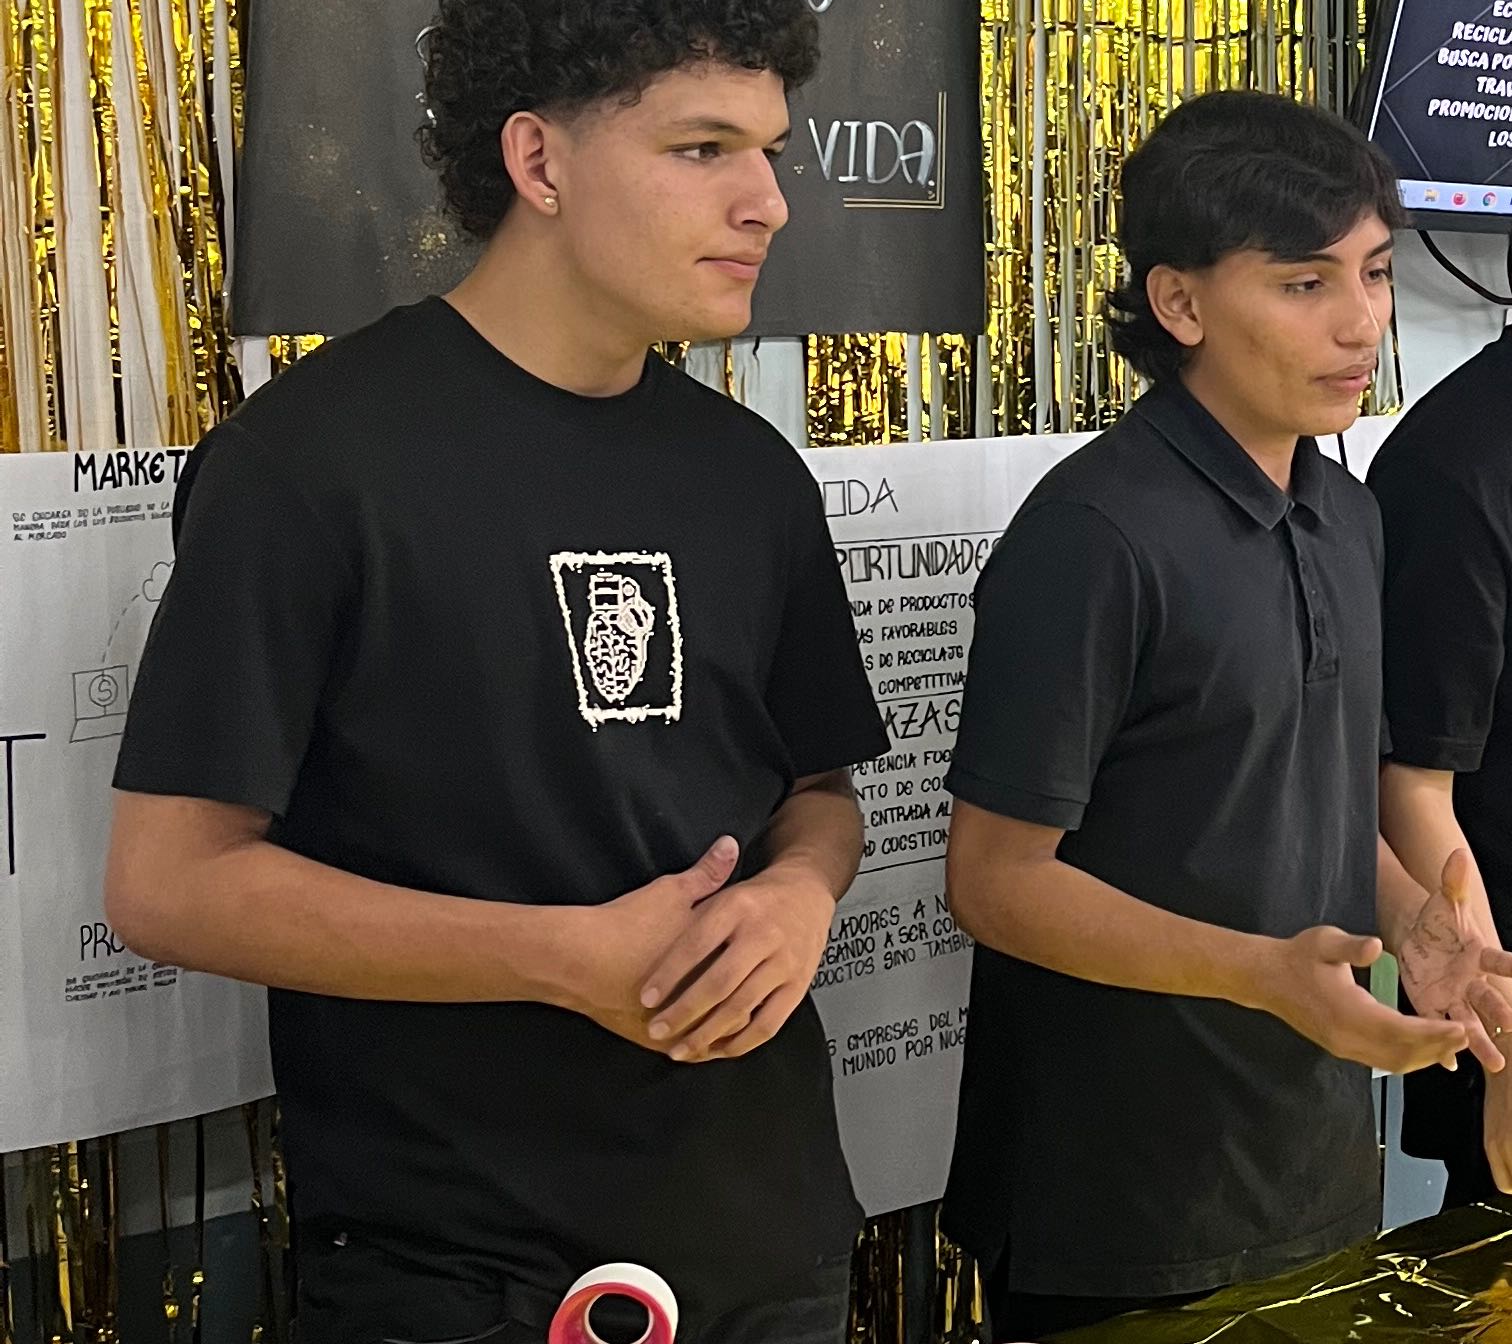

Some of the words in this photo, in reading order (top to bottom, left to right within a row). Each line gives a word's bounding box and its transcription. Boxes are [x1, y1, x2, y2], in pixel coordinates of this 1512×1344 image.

[1437, 47, 1489, 69] BUSCA
[74, 449, 192, 492] MARKET
[900, 592, 975, 612] PRODUCTOS
[881, 620, 958, 641] FAVORABLES
[897, 645, 964, 666] RECICLAJE
[896, 781, 913, 796] DE
[870, 803, 931, 828] ENTRADA
[913, 899, 925, 919] A
[884, 931, 894, 949] A
[899, 921, 928, 944] SER
[884, 947, 916, 970] SINO
[847, 1019, 919, 1051] EMPRESAS
[929, 1011, 953, 1032] DEL
[842, 1047, 896, 1076] MUNDO
[905, 1035, 933, 1060] POR
